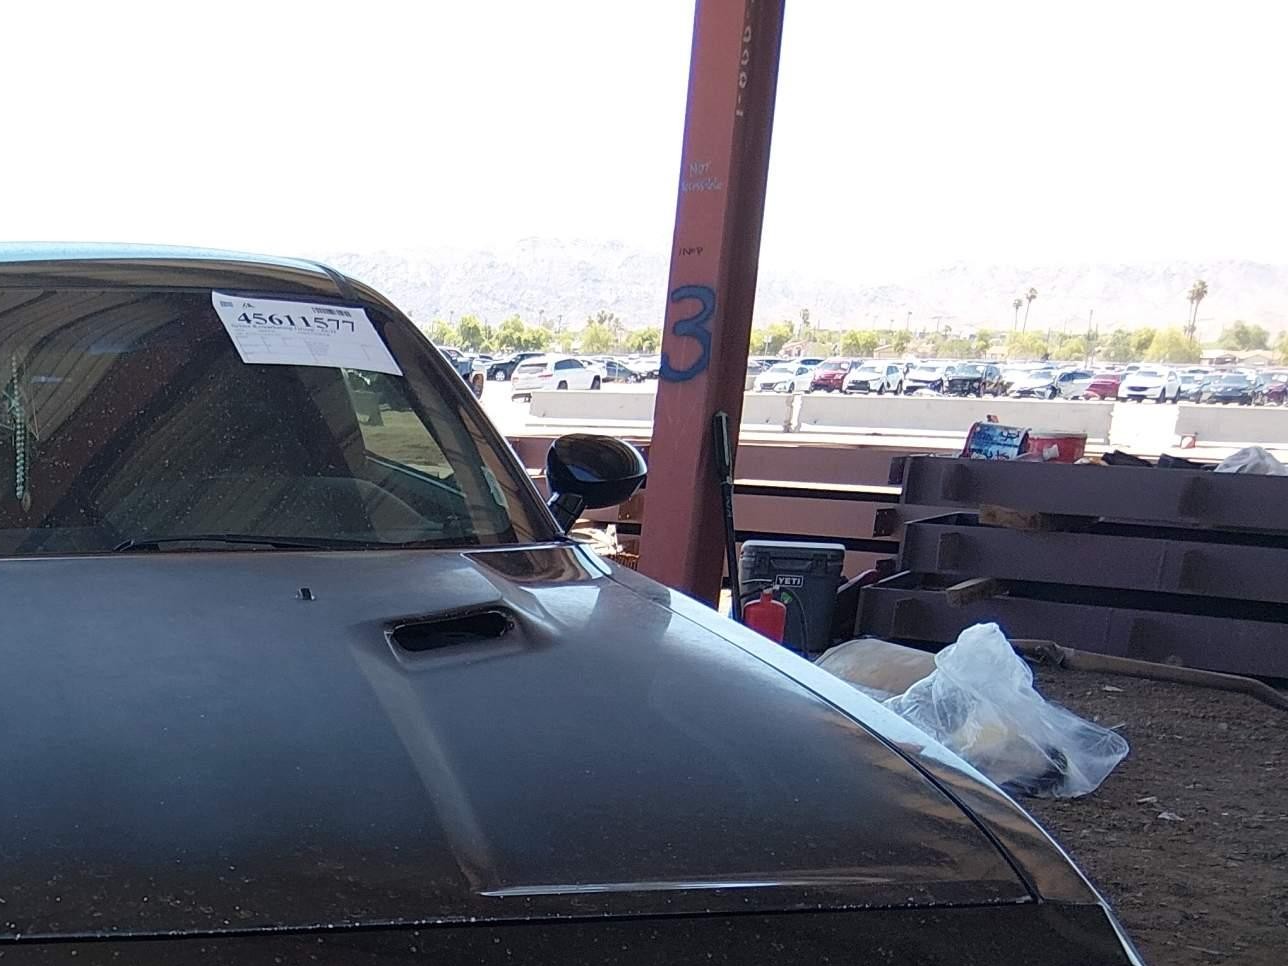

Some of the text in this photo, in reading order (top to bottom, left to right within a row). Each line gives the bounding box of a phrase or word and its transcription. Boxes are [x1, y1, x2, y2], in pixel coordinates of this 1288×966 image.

[237, 312, 355, 332] 45611577
[659, 284, 716, 383] 3
[778, 576, 801, 585] YETI
